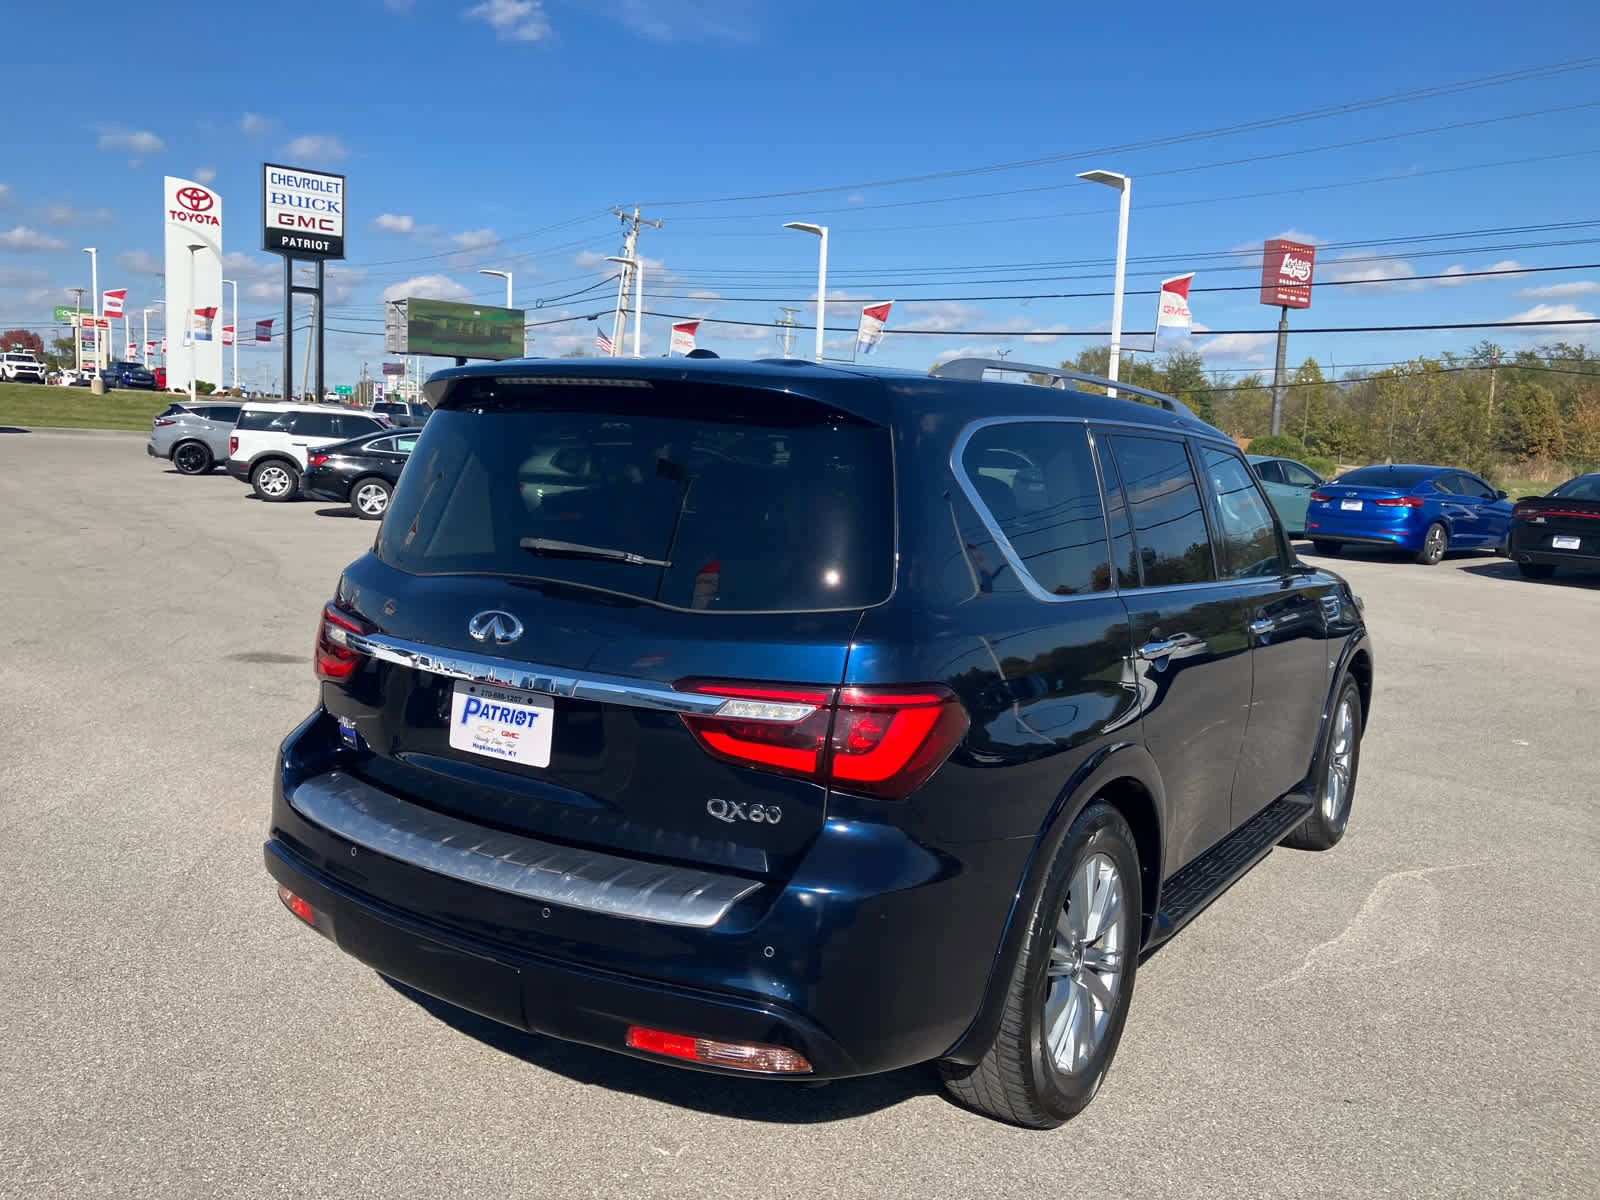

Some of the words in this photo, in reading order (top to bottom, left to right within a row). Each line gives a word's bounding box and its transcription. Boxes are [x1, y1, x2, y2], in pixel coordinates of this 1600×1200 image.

[271, 172, 341, 194] CHEVROLET
[271, 192, 341, 214] BUICK
[169, 210, 220, 227] TOYOTA
[278, 212, 335, 232] GMC
[281, 235, 330, 251] PATRIOT
[1162, 304, 1190, 317] GMC
[501, 730, 521, 740] GMC
[706, 798, 782, 825] QX80
